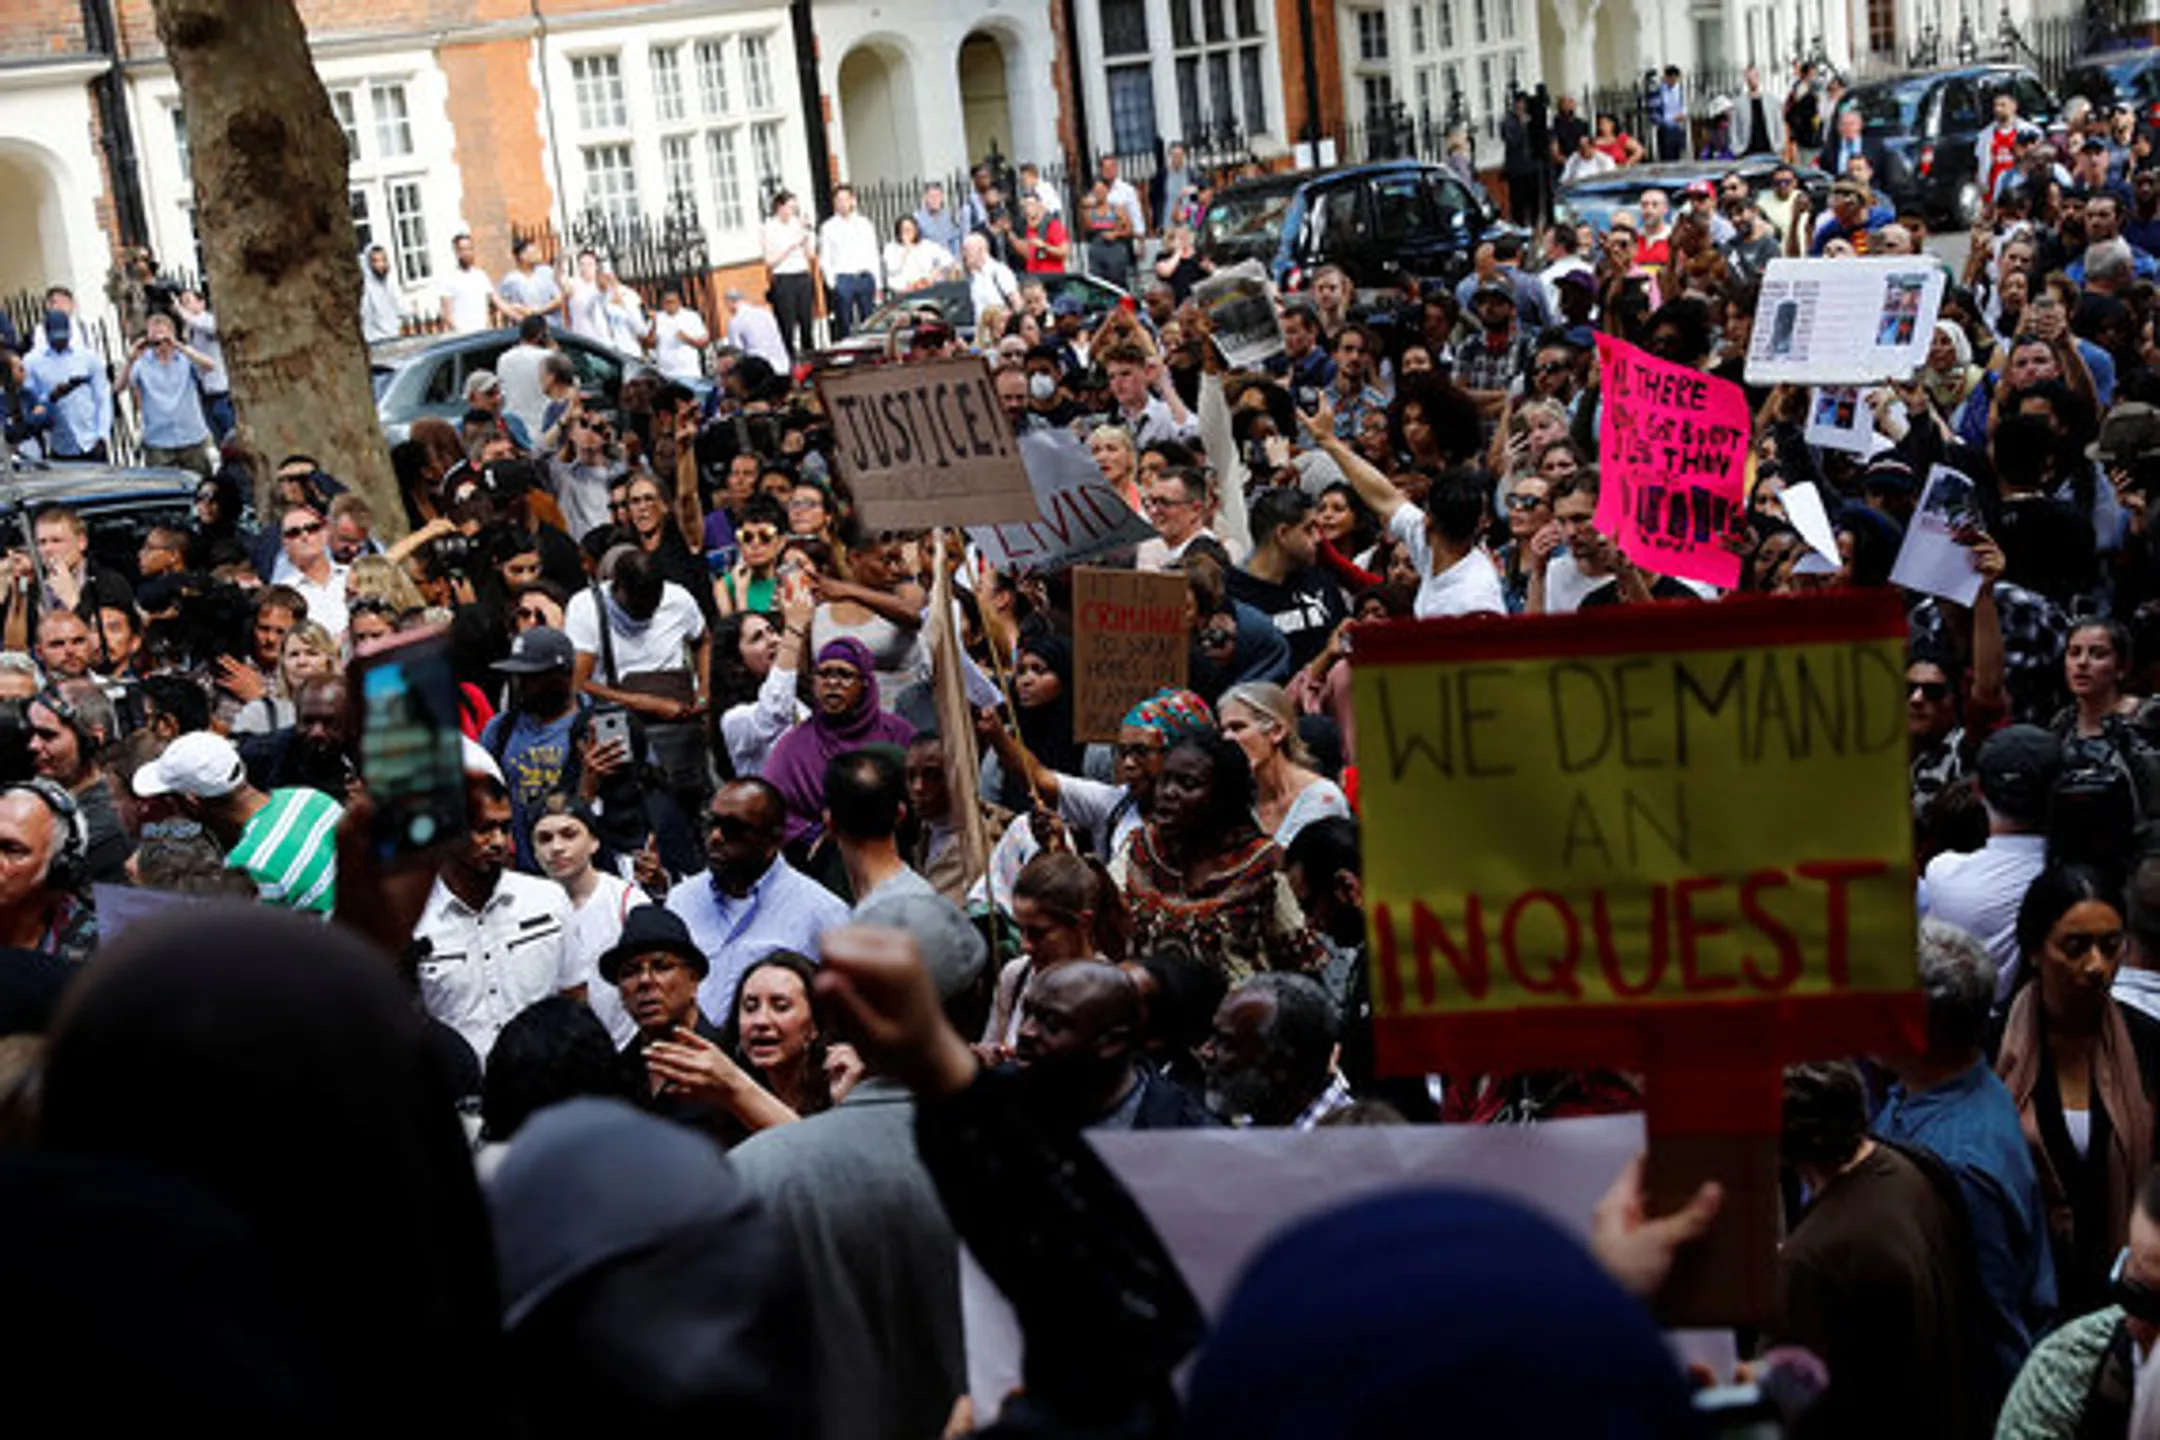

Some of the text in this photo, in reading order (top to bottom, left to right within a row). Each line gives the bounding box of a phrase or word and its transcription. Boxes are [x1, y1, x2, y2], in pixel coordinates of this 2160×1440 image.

[835, 377, 1007, 472] JUSTICE!
[1633, 363, 1707, 411] THERE
[1079, 600, 1186, 635] CRIMINAL
[1092, 634, 1119, 657] TO
[1375, 643, 1901, 783] WE DEMAND
[1561, 780, 1692, 870] AN
[1373, 858, 1888, 1014] INQUEST
